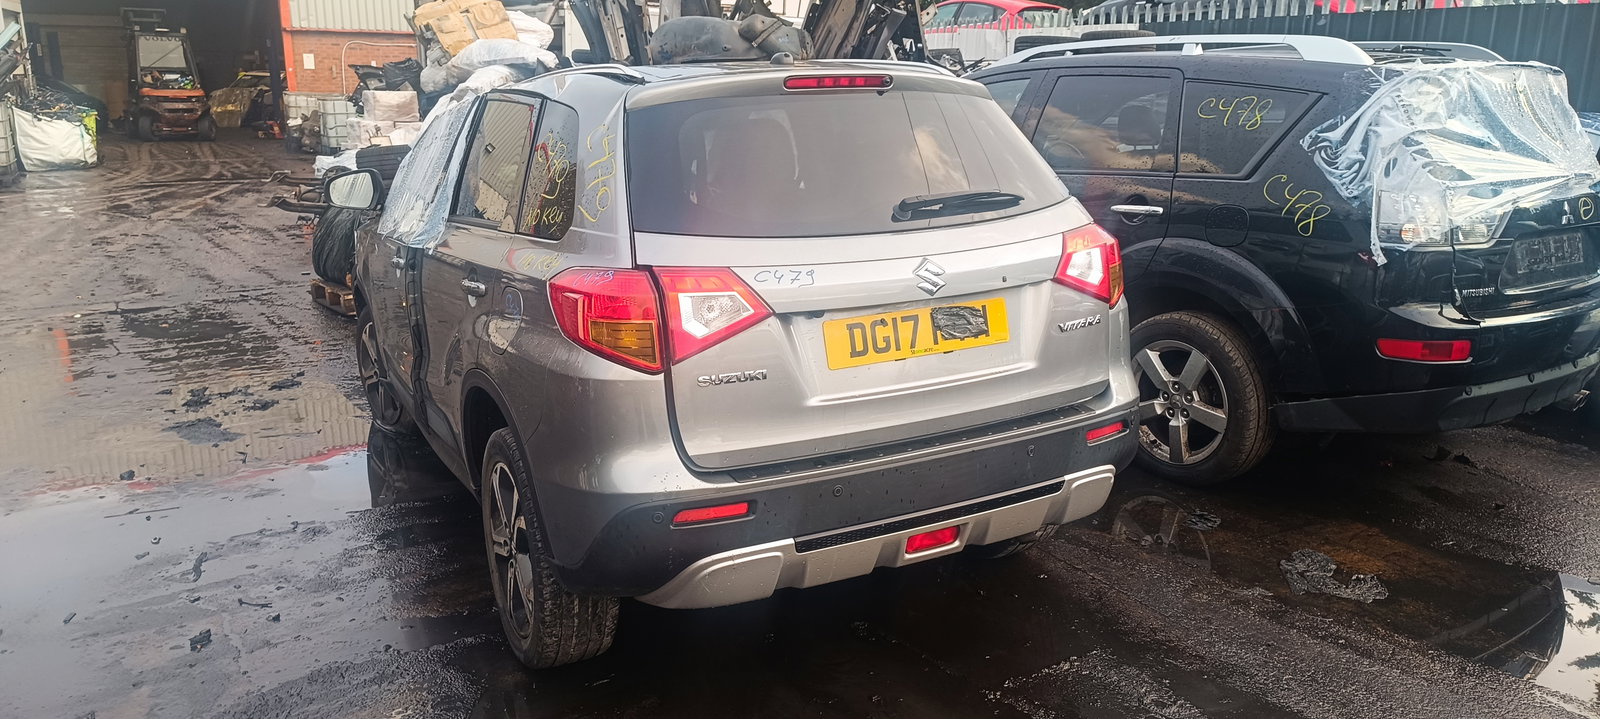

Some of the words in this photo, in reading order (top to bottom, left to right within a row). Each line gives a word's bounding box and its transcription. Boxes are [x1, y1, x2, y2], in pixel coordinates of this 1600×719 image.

[1197, 96, 1273, 130] C478
[578, 124, 616, 222] C479
[1263, 174, 1331, 237] C478
[754, 269, 815, 288] C479
[1461, 287, 1496, 298] MITSUBISHI
[846, 314, 920, 358] DG17
[1057, 314, 1101, 333] VITARA
[697, 369, 768, 388] SUZUKI
